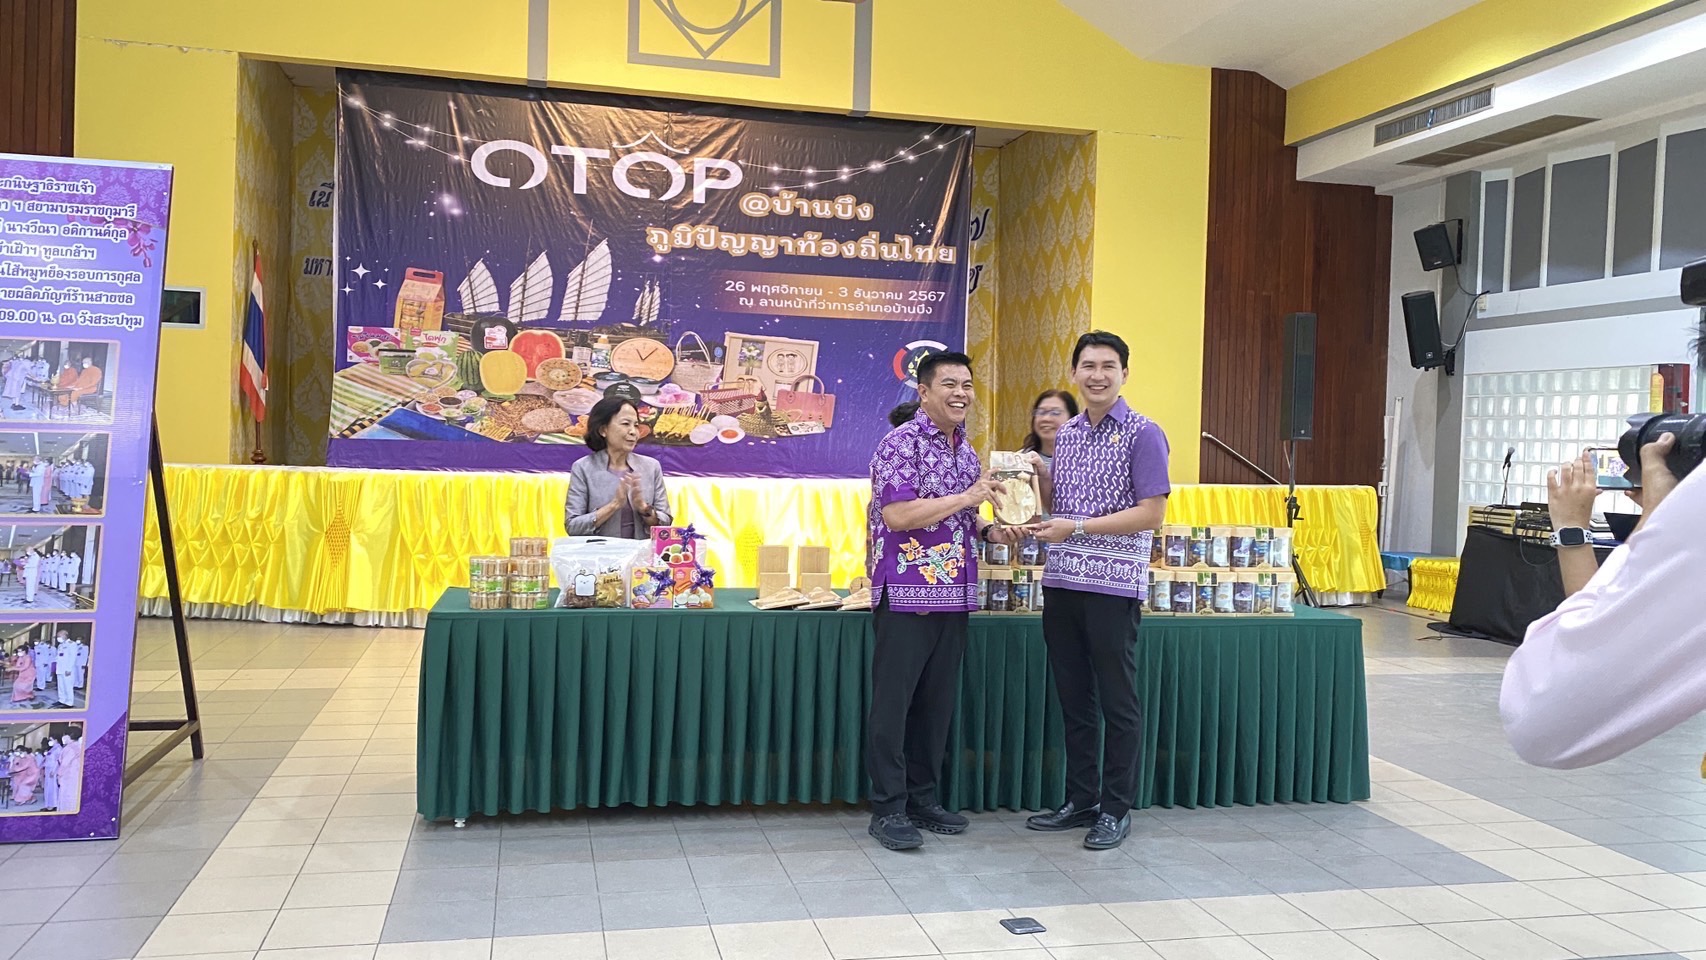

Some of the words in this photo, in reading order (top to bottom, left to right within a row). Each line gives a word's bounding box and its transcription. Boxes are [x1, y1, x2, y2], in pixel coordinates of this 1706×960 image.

[470, 138, 743, 204] OTOP
[26, 202, 136, 220] สยามบรมราชกุมารี
[741, 191, 873, 221] @บ้านบึง
[648, 225, 955, 263] ภูมิปัญญาท้องถิ่นไทย
[304, 257, 334, 276] มหา
[724, 280, 746, 292] 26
[751, 284, 823, 296] พฤศจิกายน
[838, 286, 848, 297] 3
[853, 287, 903, 300] ธันวาคม
[908, 290, 946, 302] 2567
[759, 297, 933, 315] ลานหน้าที่ว่าการอำเภอบ้านบึง
[41, 313, 55, 323] น.
[60, 314, 74, 324] ณ
[79, 311, 142, 329] วังสระปทุม
